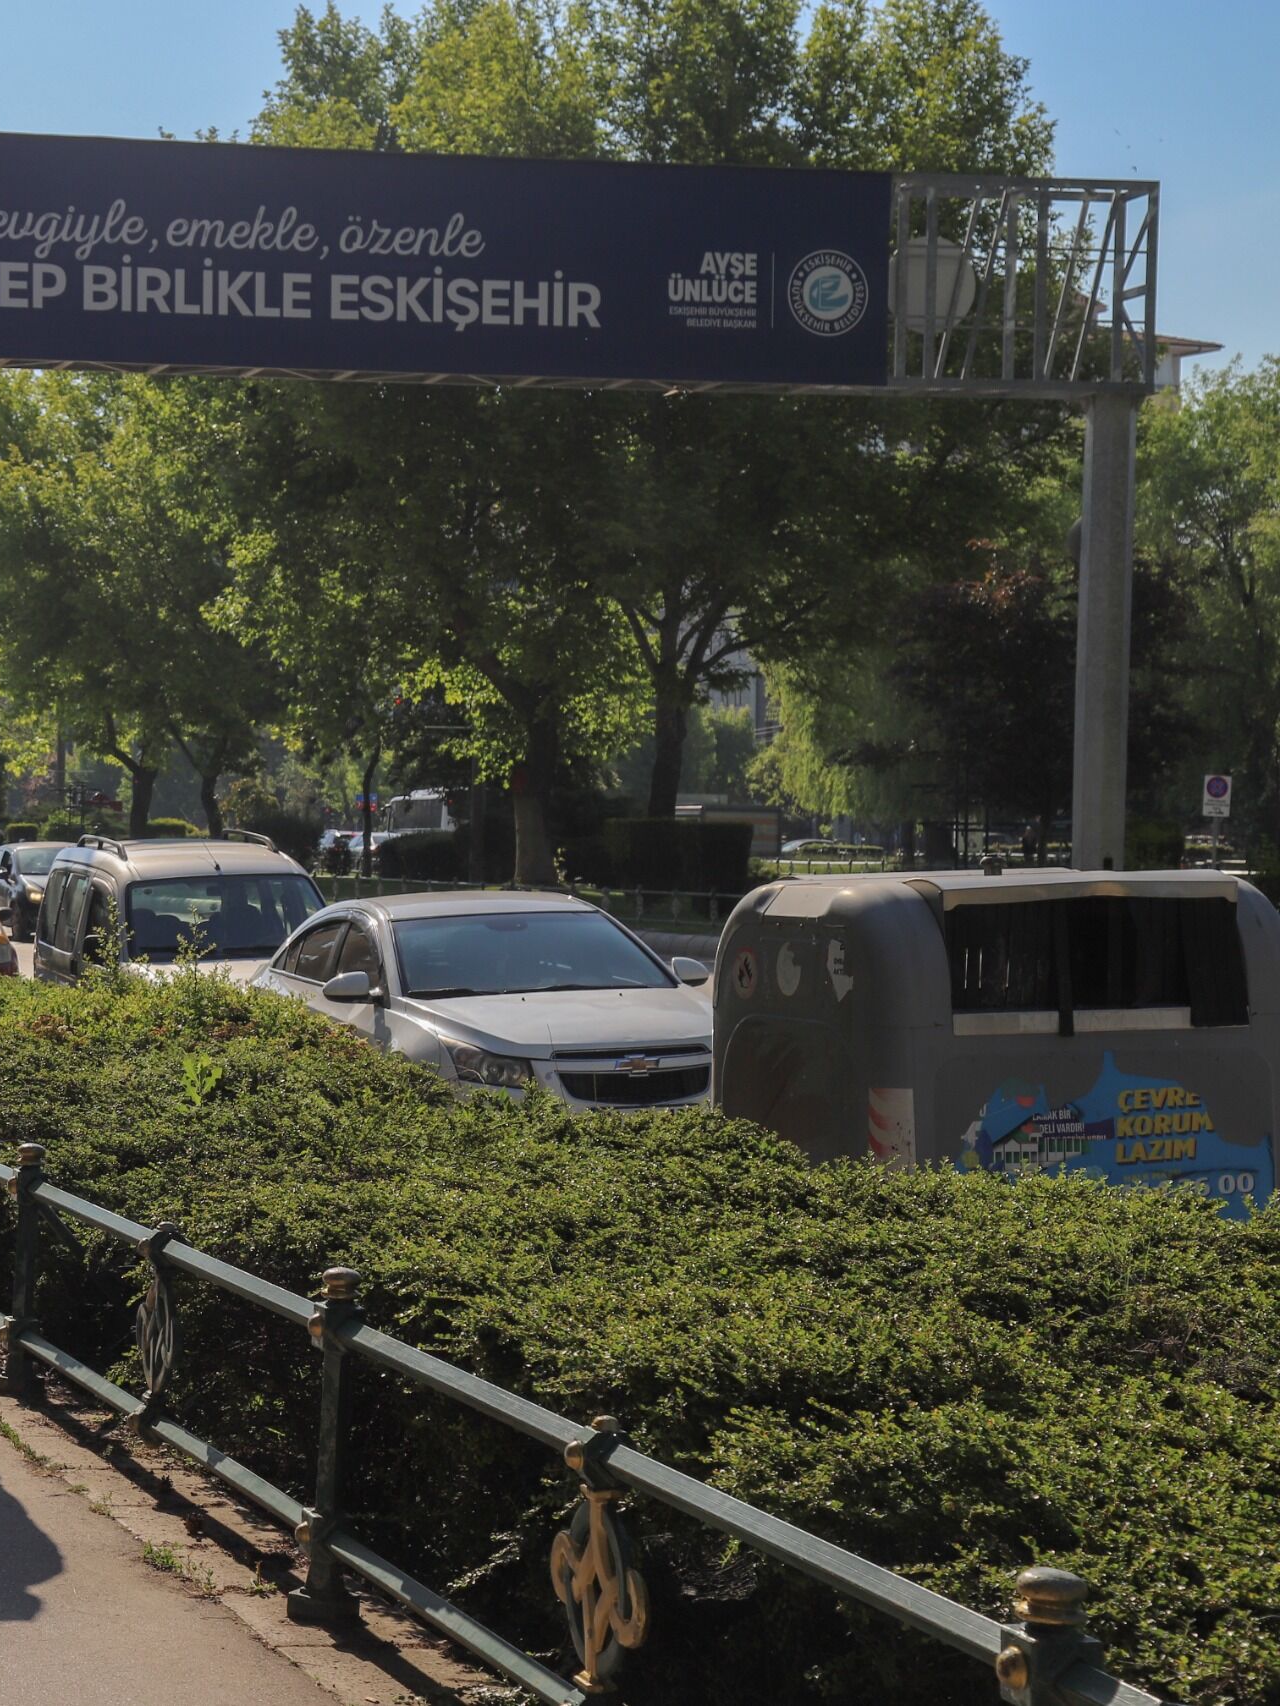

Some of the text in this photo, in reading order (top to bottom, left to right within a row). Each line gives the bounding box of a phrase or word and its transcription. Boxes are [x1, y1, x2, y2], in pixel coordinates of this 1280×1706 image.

[166, 205, 329, 260] emekle,
[339, 213, 485, 257] özenle
[700, 252, 757, 277] AYŞE
[83, 254, 312, 319] BİRLİKLE
[330, 266, 601, 332] ESKİŞEHİR
[668, 273, 757, 304] ÜNLÜCE
[1116, 1111, 1216, 1138] KORUM
[1115, 1137, 1197, 1165] LAZIM
[1218, 1172, 1256, 1195] 00
